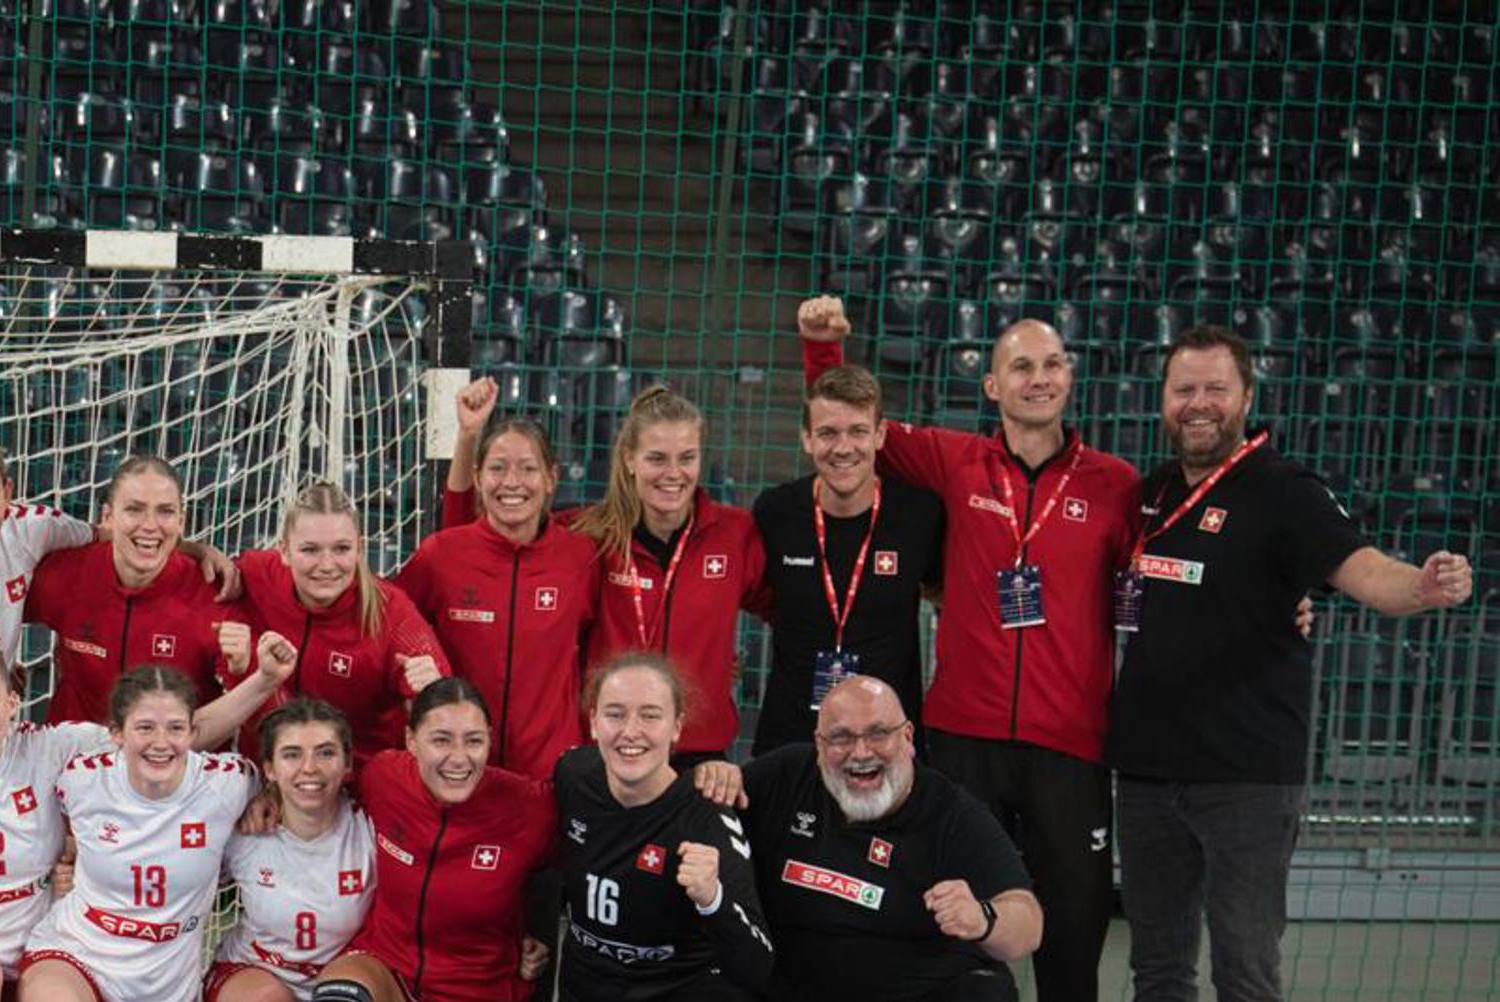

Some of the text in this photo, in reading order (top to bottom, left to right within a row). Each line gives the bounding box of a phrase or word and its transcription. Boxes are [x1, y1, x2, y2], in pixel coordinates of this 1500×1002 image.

[1139, 559, 1184, 577] SPAR
[130, 865, 166, 907] 13
[586, 873, 619, 925] 16
[801, 869, 860, 899] SPAR
[100, 915, 179, 941] SPAR
[296, 912, 316, 949] 8
